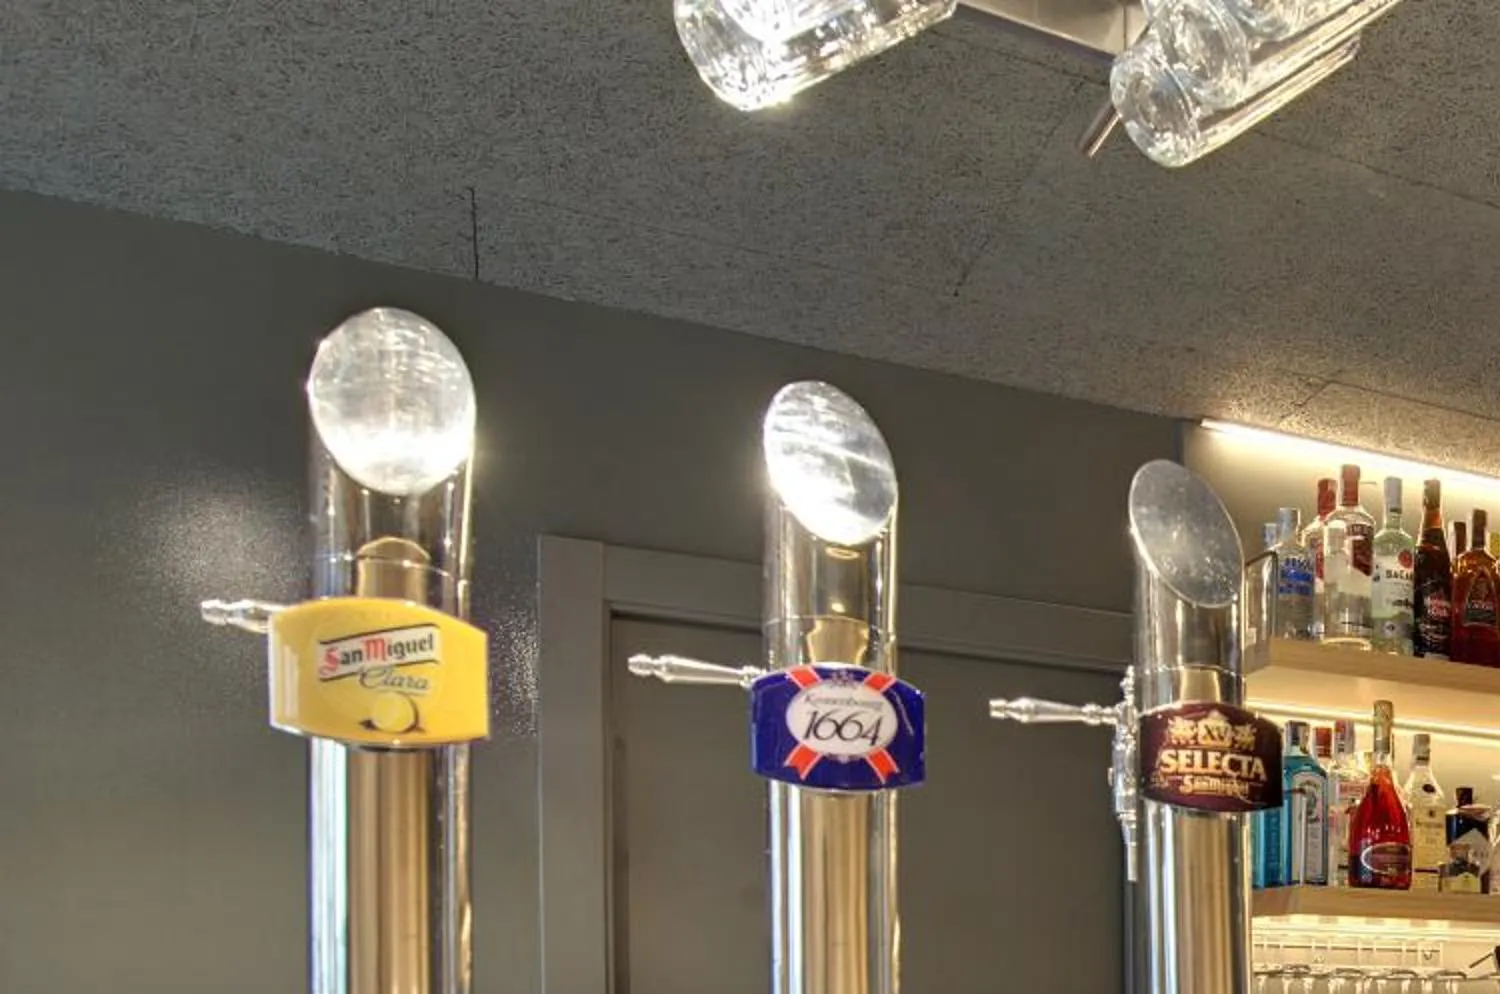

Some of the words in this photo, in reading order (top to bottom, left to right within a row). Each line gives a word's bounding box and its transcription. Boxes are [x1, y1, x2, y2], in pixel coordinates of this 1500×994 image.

[321, 647, 362, 672] San
[363, 634, 434, 661] Miguel
[359, 667, 429, 690] Clara
[803, 708, 883, 746] 1664
[1159, 749, 1268, 782] SELECTA
